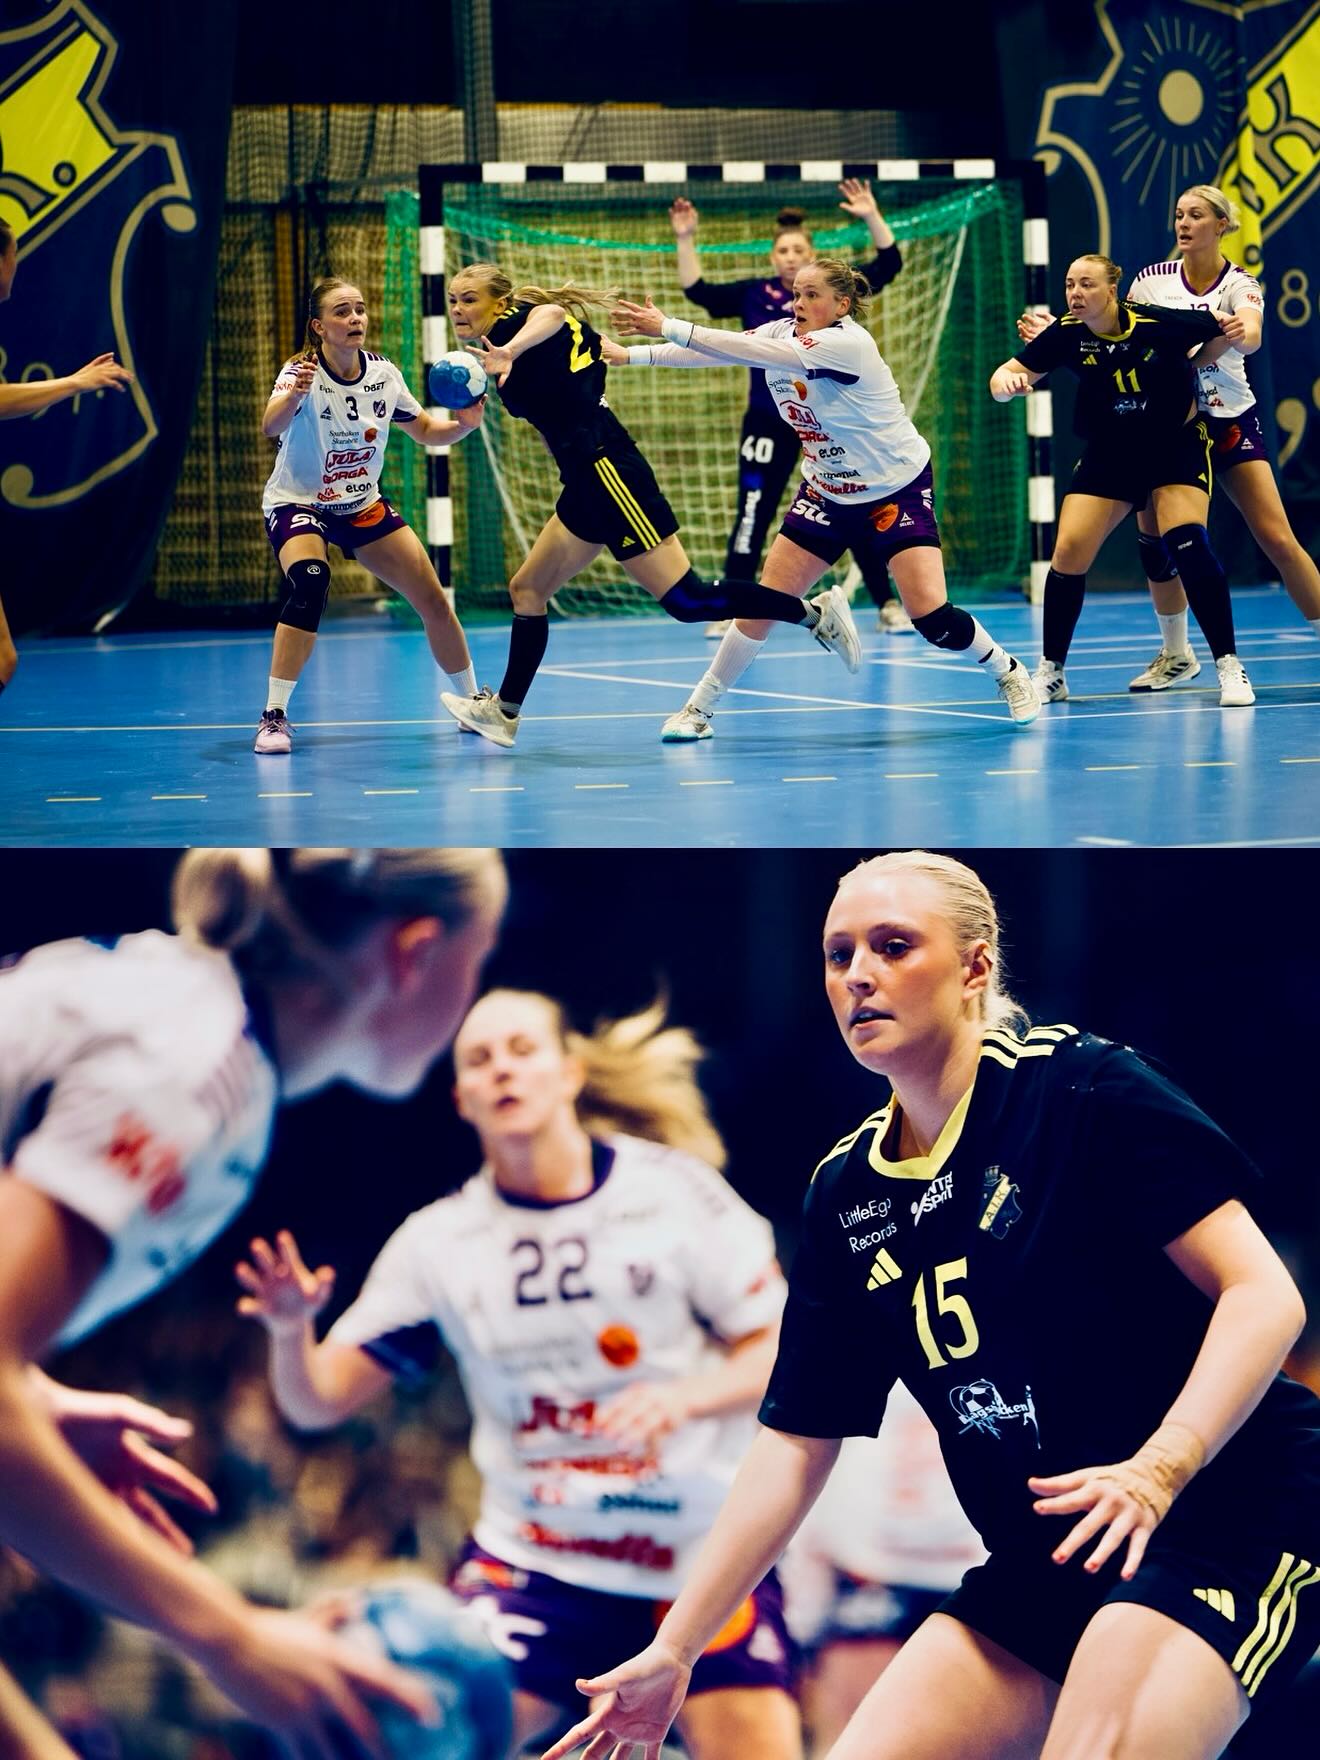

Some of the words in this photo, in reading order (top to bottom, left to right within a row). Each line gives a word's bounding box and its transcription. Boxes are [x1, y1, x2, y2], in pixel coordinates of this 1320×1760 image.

[1112, 367, 1142, 393] 11
[345, 395, 360, 421] 3
[327, 450, 372, 469] JULA
[741, 435, 775, 464] 40
[511, 1237, 593, 1307] 22
[911, 1256, 980, 1370] 15
